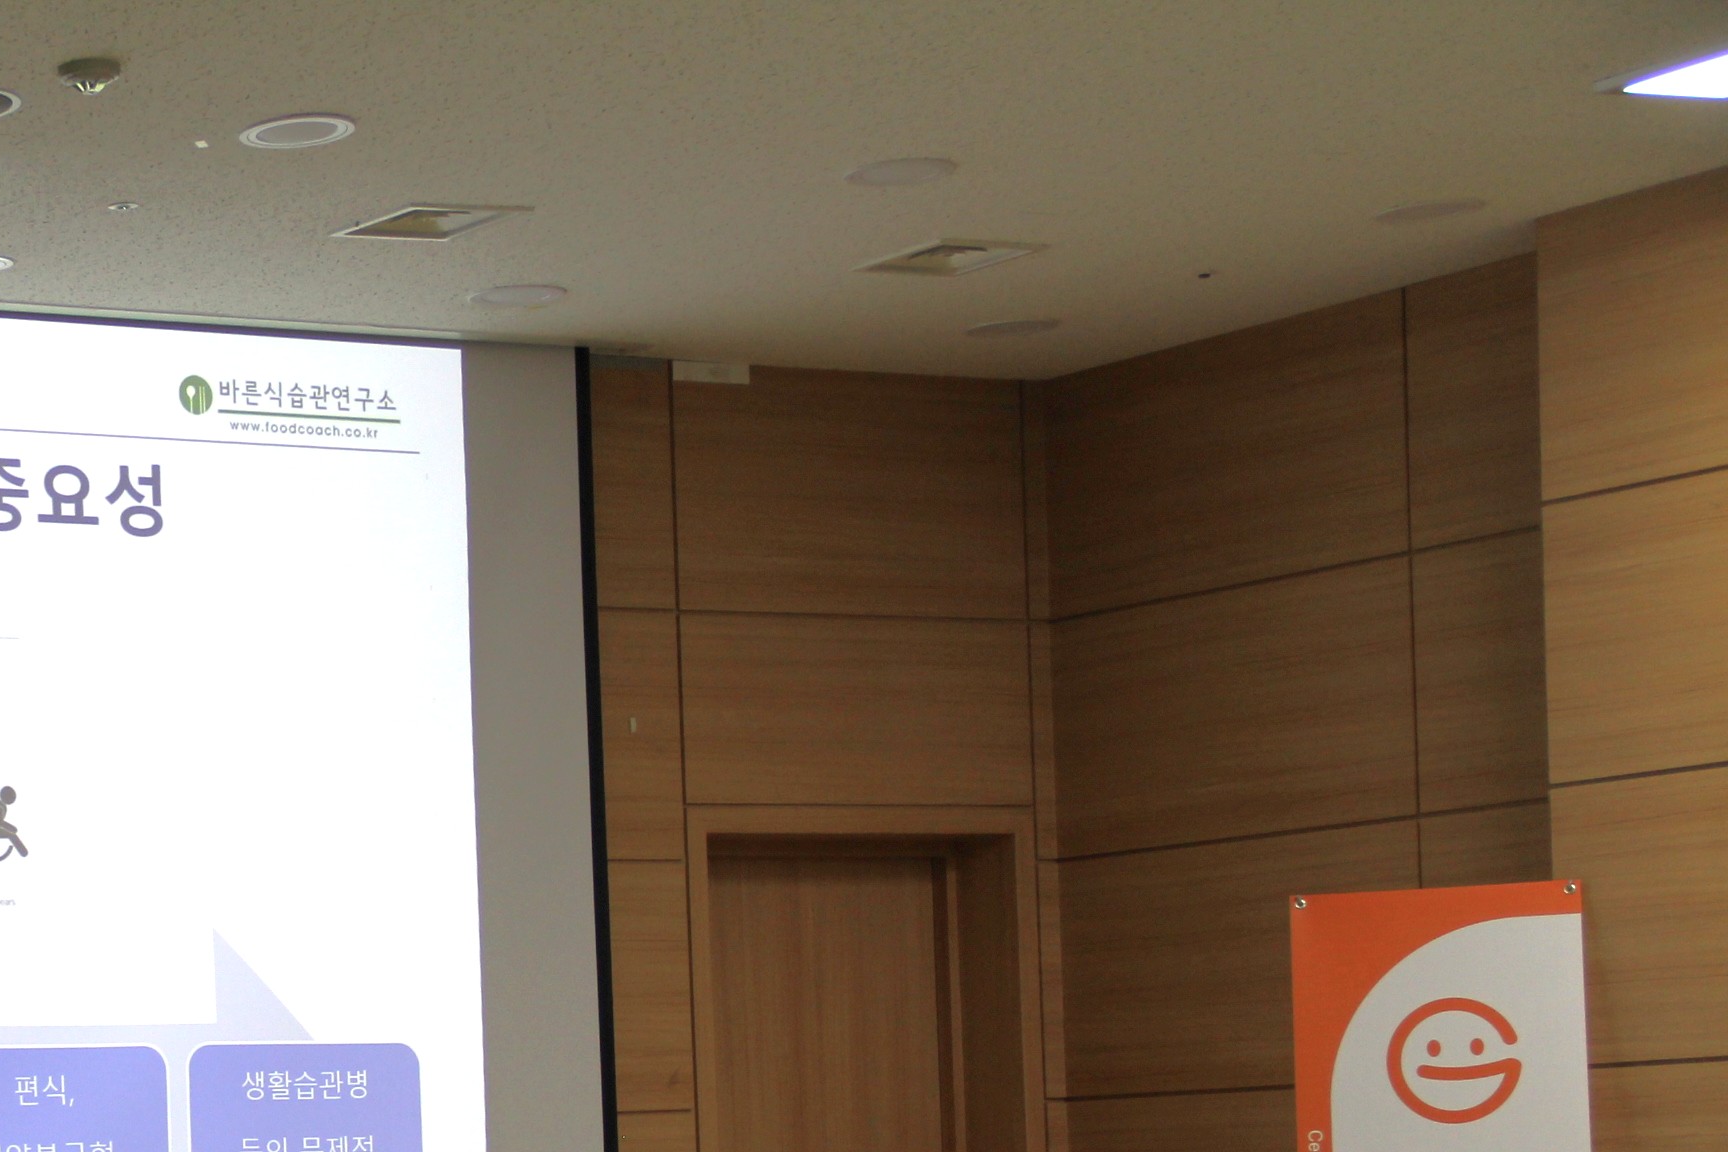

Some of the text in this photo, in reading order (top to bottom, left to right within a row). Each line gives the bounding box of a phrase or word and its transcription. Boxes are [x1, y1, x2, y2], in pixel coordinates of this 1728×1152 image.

[219, 378, 397, 412] 바른식습관연구소
[229, 421, 379, 439] www.foodcoach.co.kr
[14, 1074, 75, 1108] 편식,
[241, 1069, 369, 1101] 생활습관병
